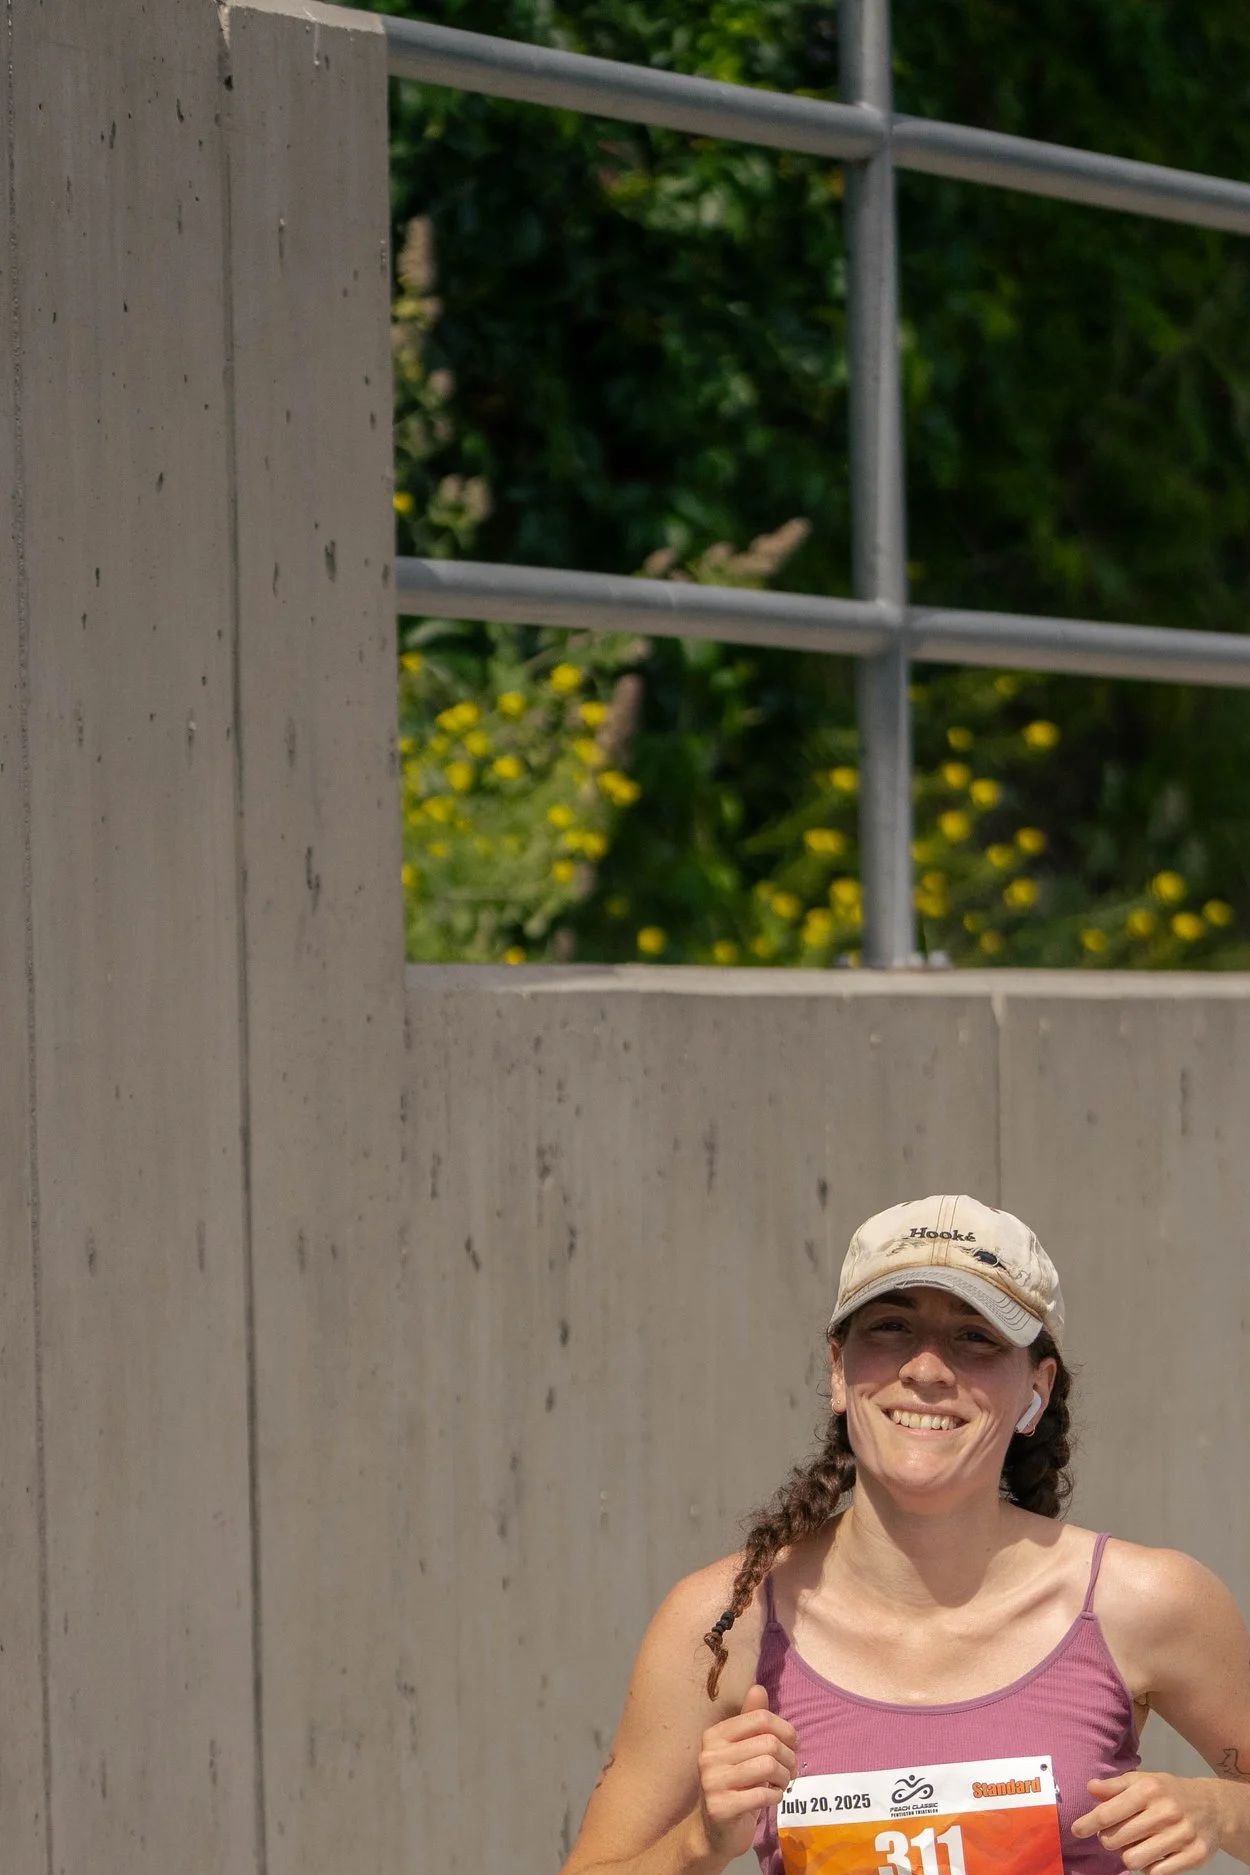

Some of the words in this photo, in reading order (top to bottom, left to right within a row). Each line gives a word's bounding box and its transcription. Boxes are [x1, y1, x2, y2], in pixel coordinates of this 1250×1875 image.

[909, 1227, 977, 1242] Hooké
[971, 1777, 1042, 1799] Standard
[780, 1798, 807, 1815] July
[810, 1797, 832, 1813] 20,
[834, 1793, 871, 1811] 2025
[912, 1802, 939, 1810] CLASSIC
